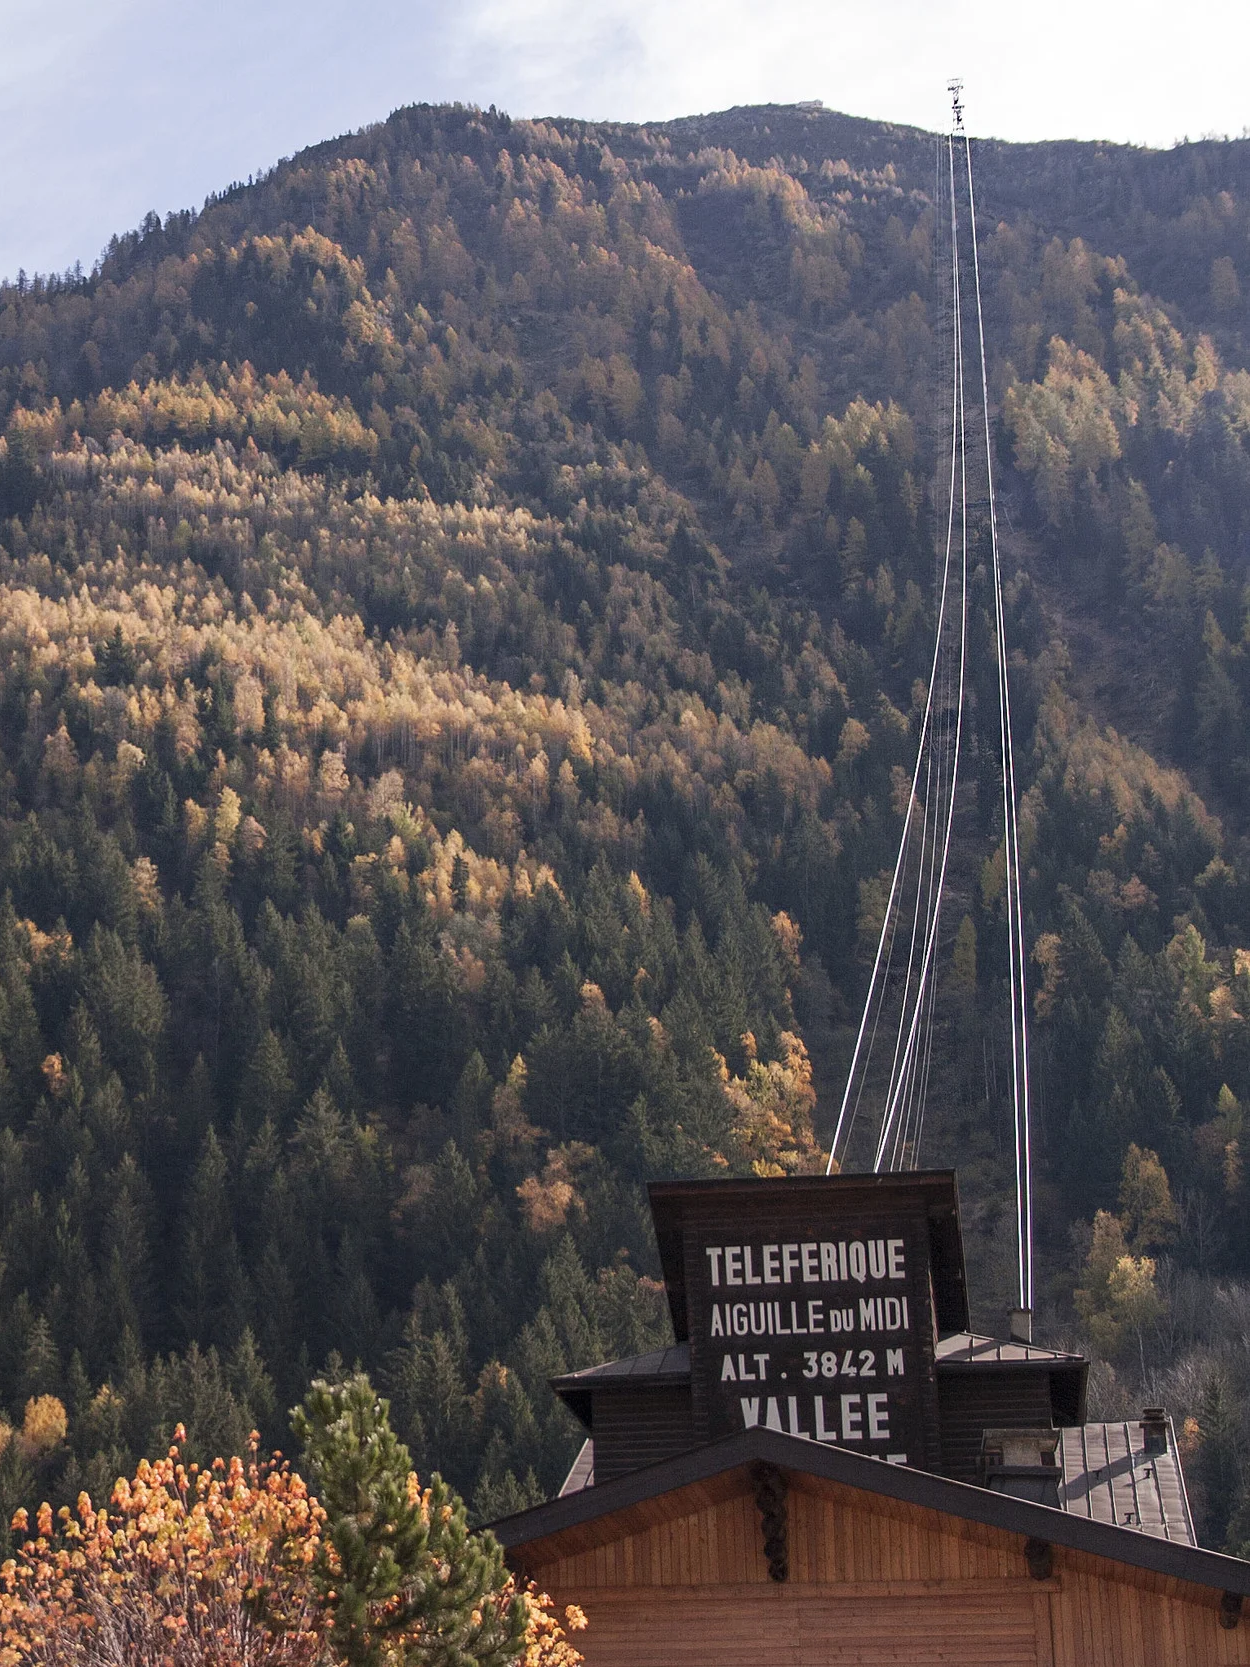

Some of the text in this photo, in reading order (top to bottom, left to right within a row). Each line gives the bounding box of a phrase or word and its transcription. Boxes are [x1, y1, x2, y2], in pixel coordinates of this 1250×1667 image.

[706, 1239, 906, 1286] TELEFERIQUE
[711, 1296, 909, 1337] AIGUILLE DU MIDI
[802, 1350, 876, 1378] 3842
[887, 1348, 905, 1376] M
[740, 1393, 890, 1440] VALLEE
